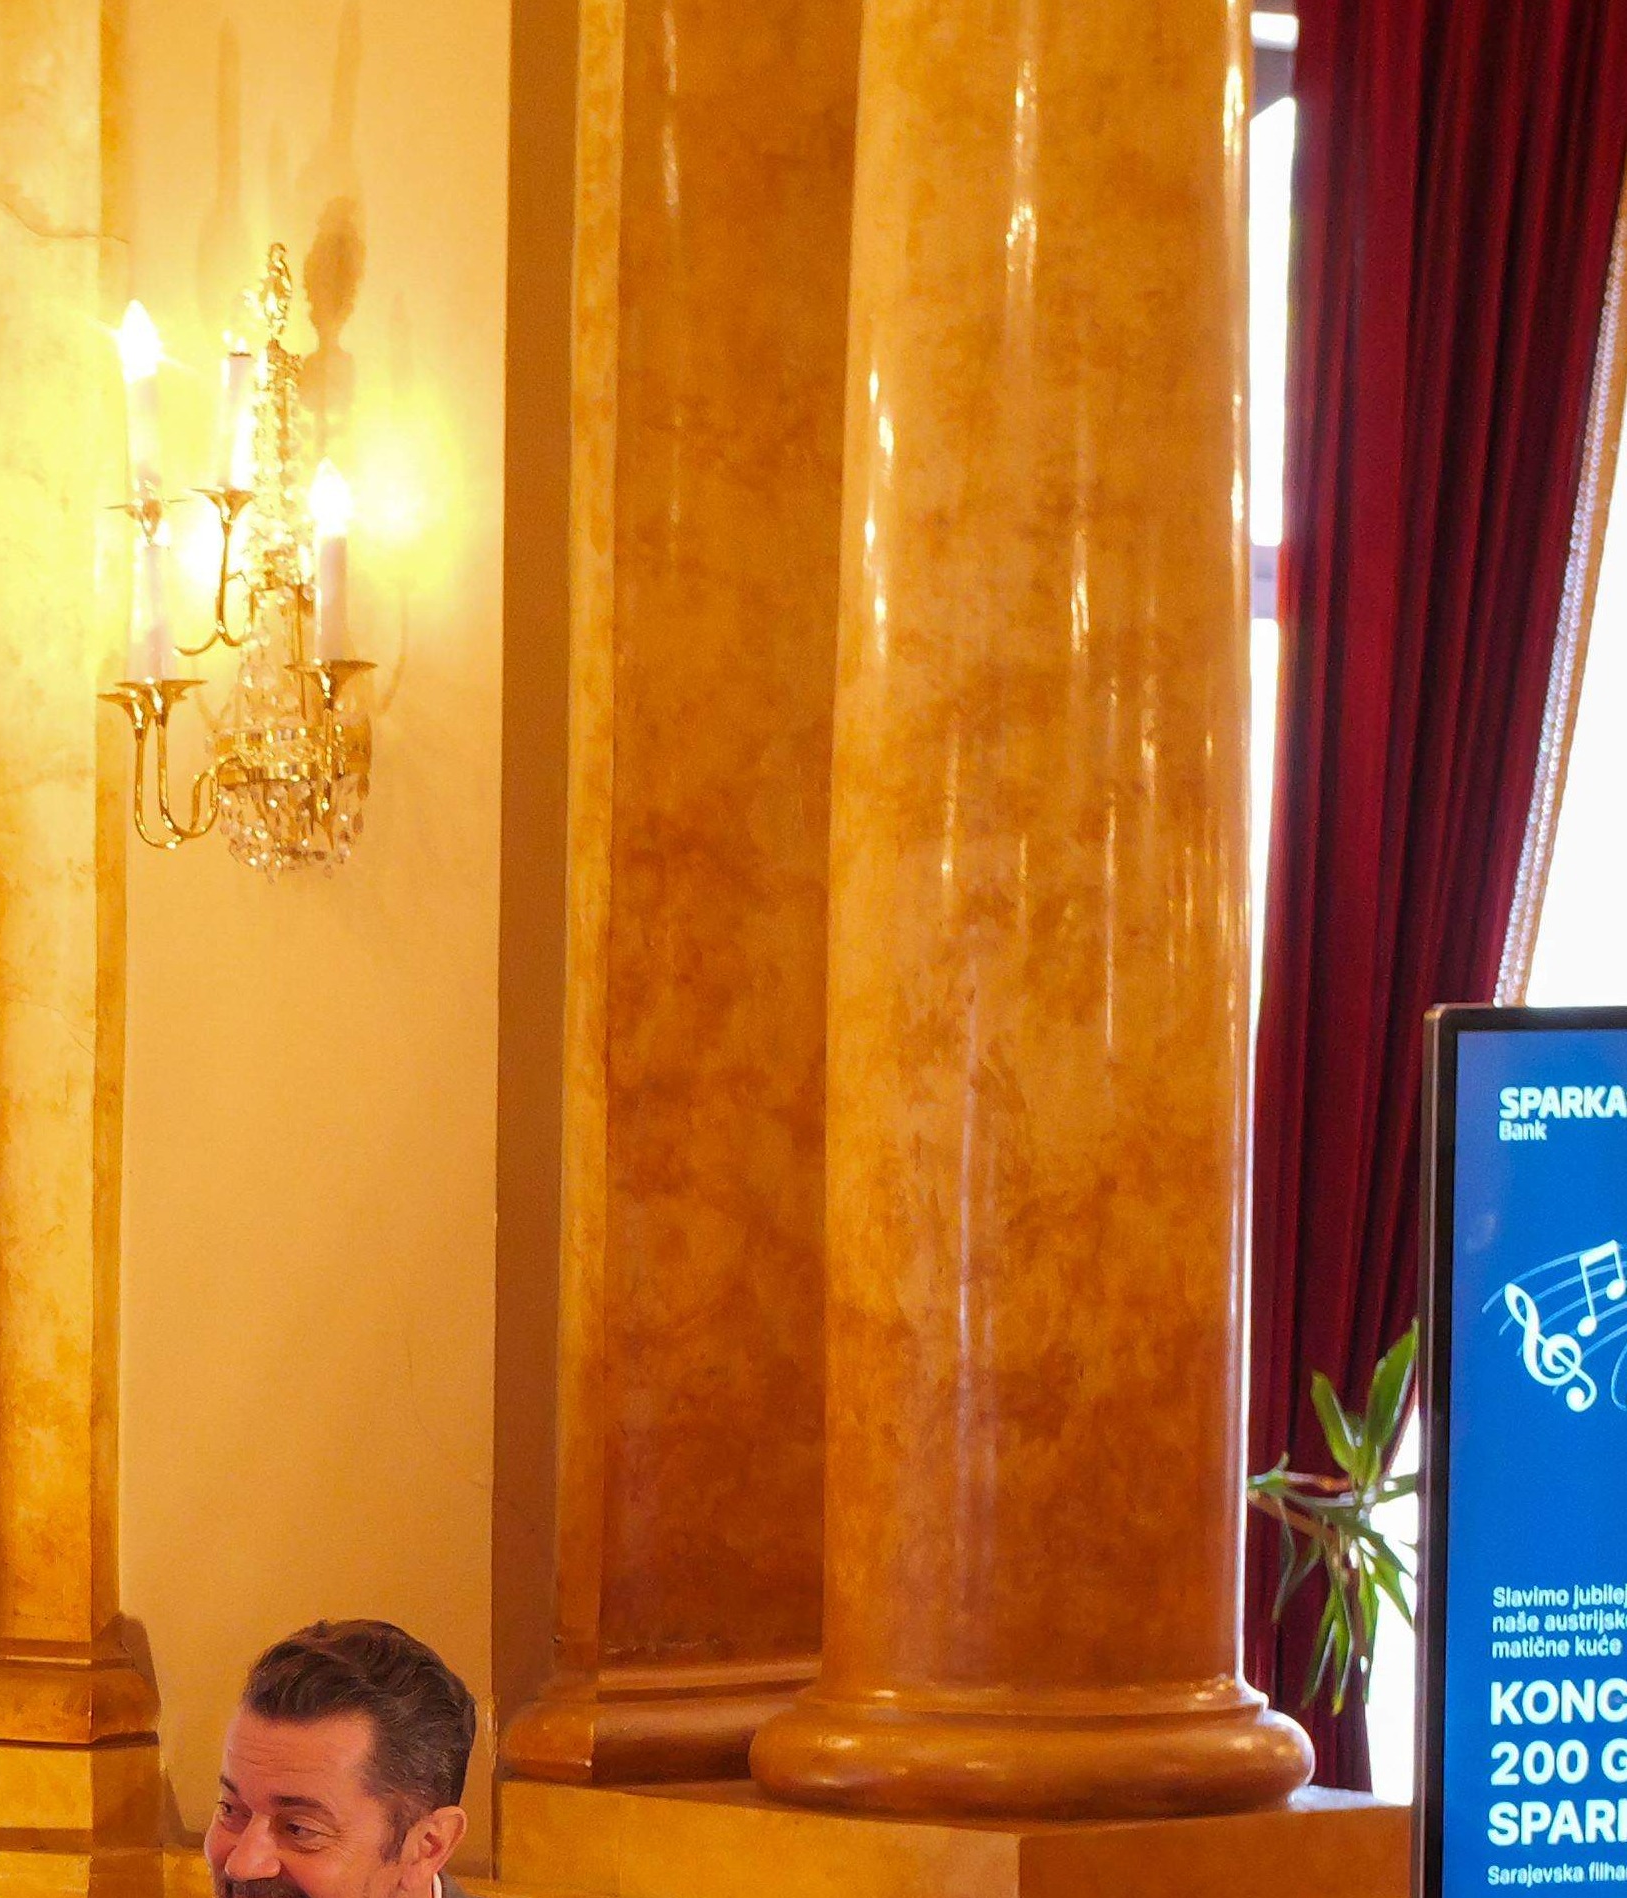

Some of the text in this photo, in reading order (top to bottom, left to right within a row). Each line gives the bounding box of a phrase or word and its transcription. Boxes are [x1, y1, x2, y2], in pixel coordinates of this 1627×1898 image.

[1499, 1086, 1627, 1119] SPARKA
[1499, 1120, 1547, 1141] Bank
[1493, 1586, 1569, 1608] Slavimo
[1544, 1608, 1627, 1635] austrijsk
[1490, 1677, 1627, 1726] KONC
[1490, 1739, 1589, 1786] 200
[1487, 1863, 1585, 1888] Sarajevska
